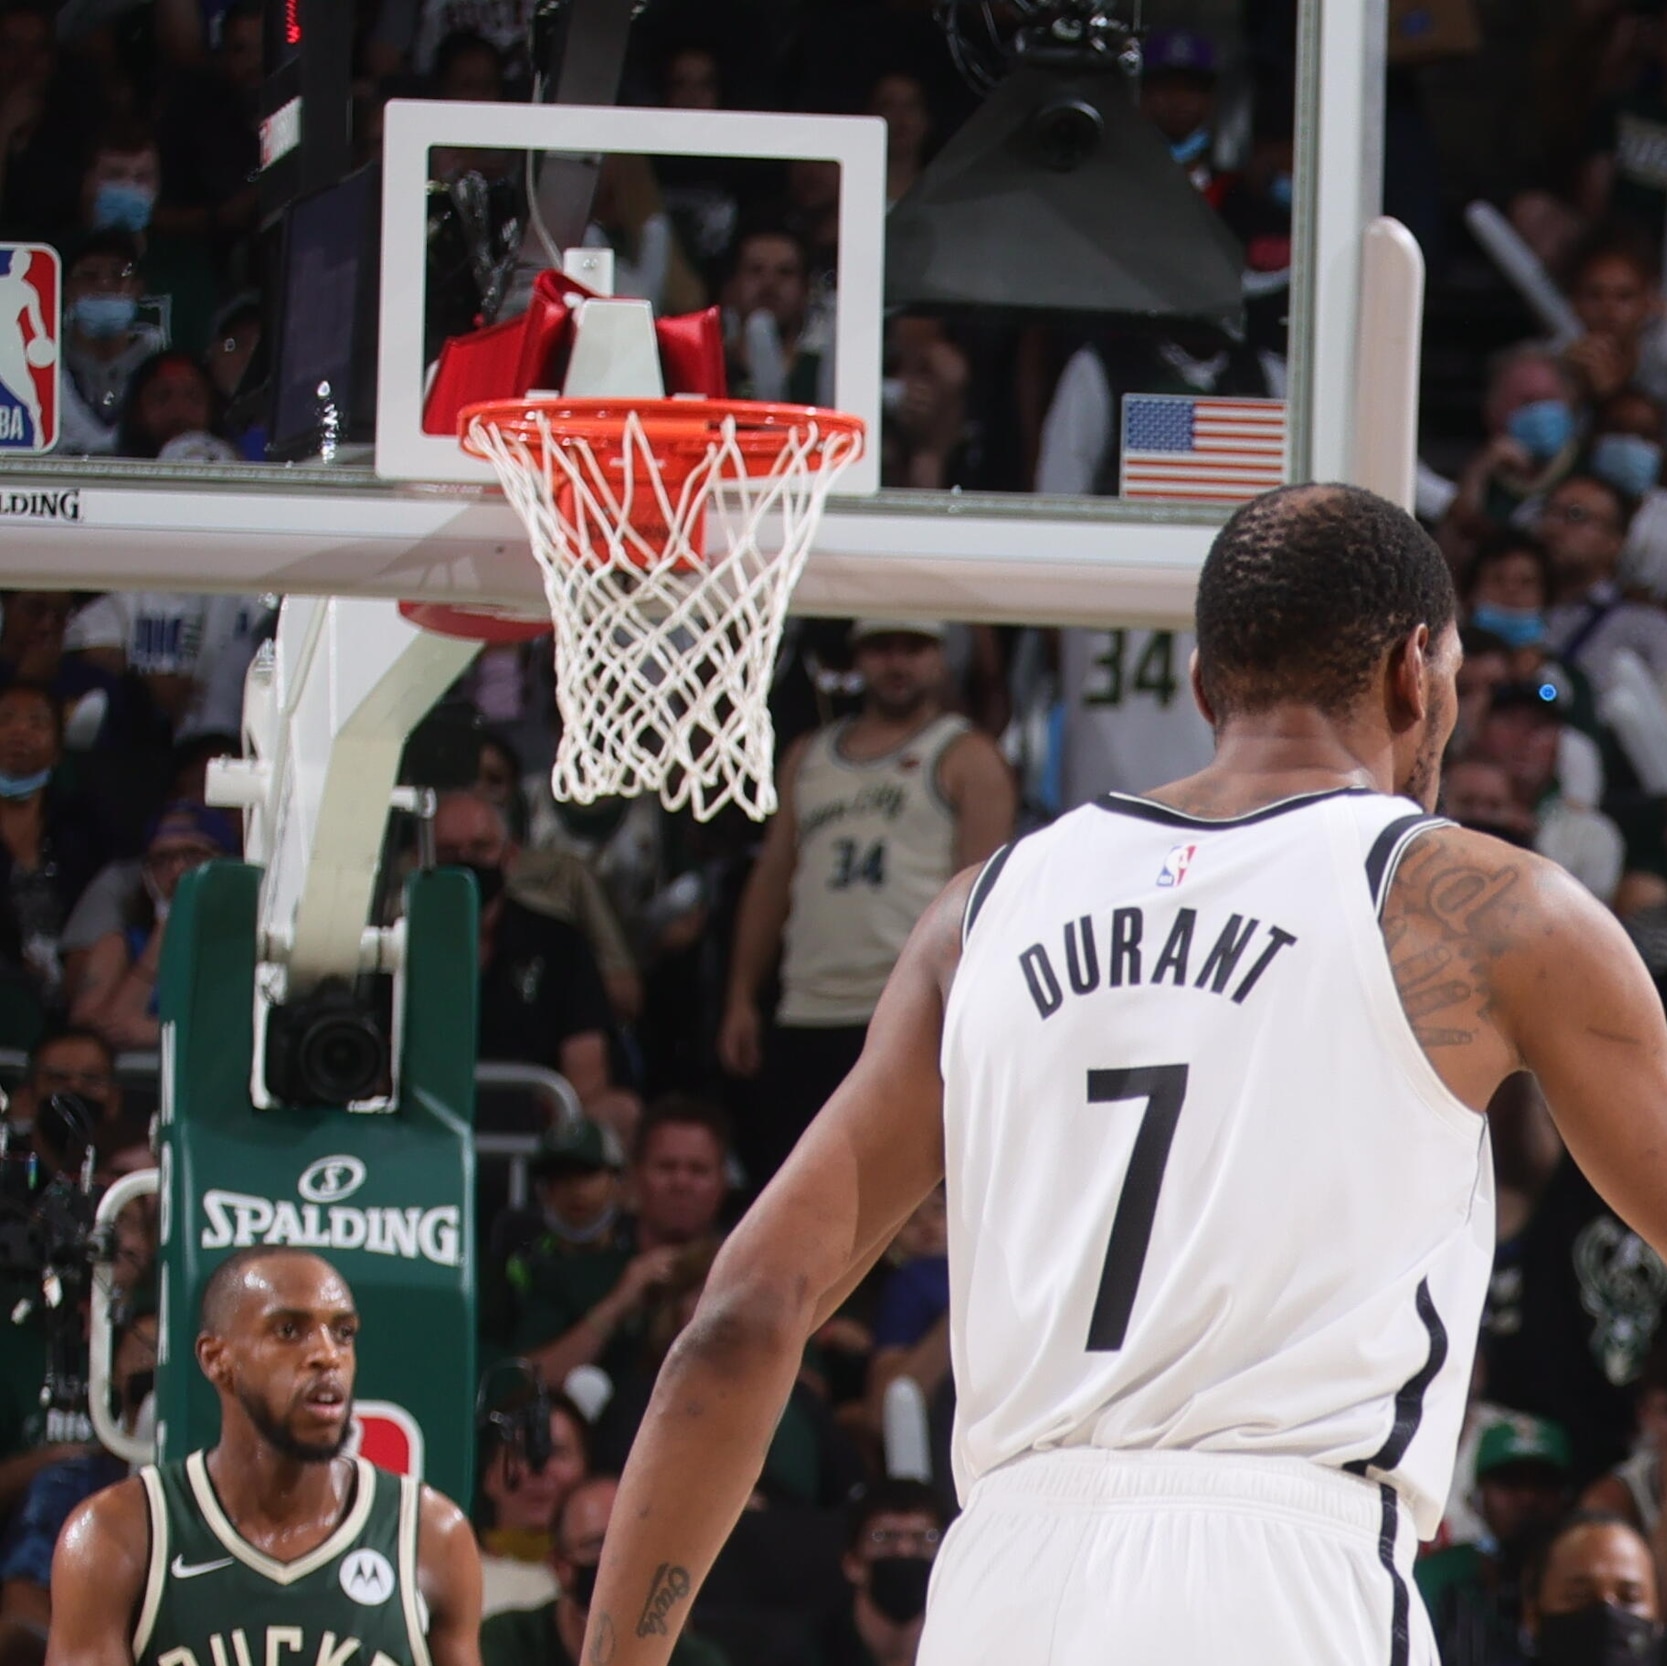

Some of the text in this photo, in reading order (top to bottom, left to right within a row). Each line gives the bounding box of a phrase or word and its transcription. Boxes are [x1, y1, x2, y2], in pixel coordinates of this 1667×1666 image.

[1082, 630, 1178, 708] 34
[1018, 906, 1298, 1021] DURANT
[201, 1188, 460, 1267] SPALDING
[1087, 1063, 1189, 1353] 7
